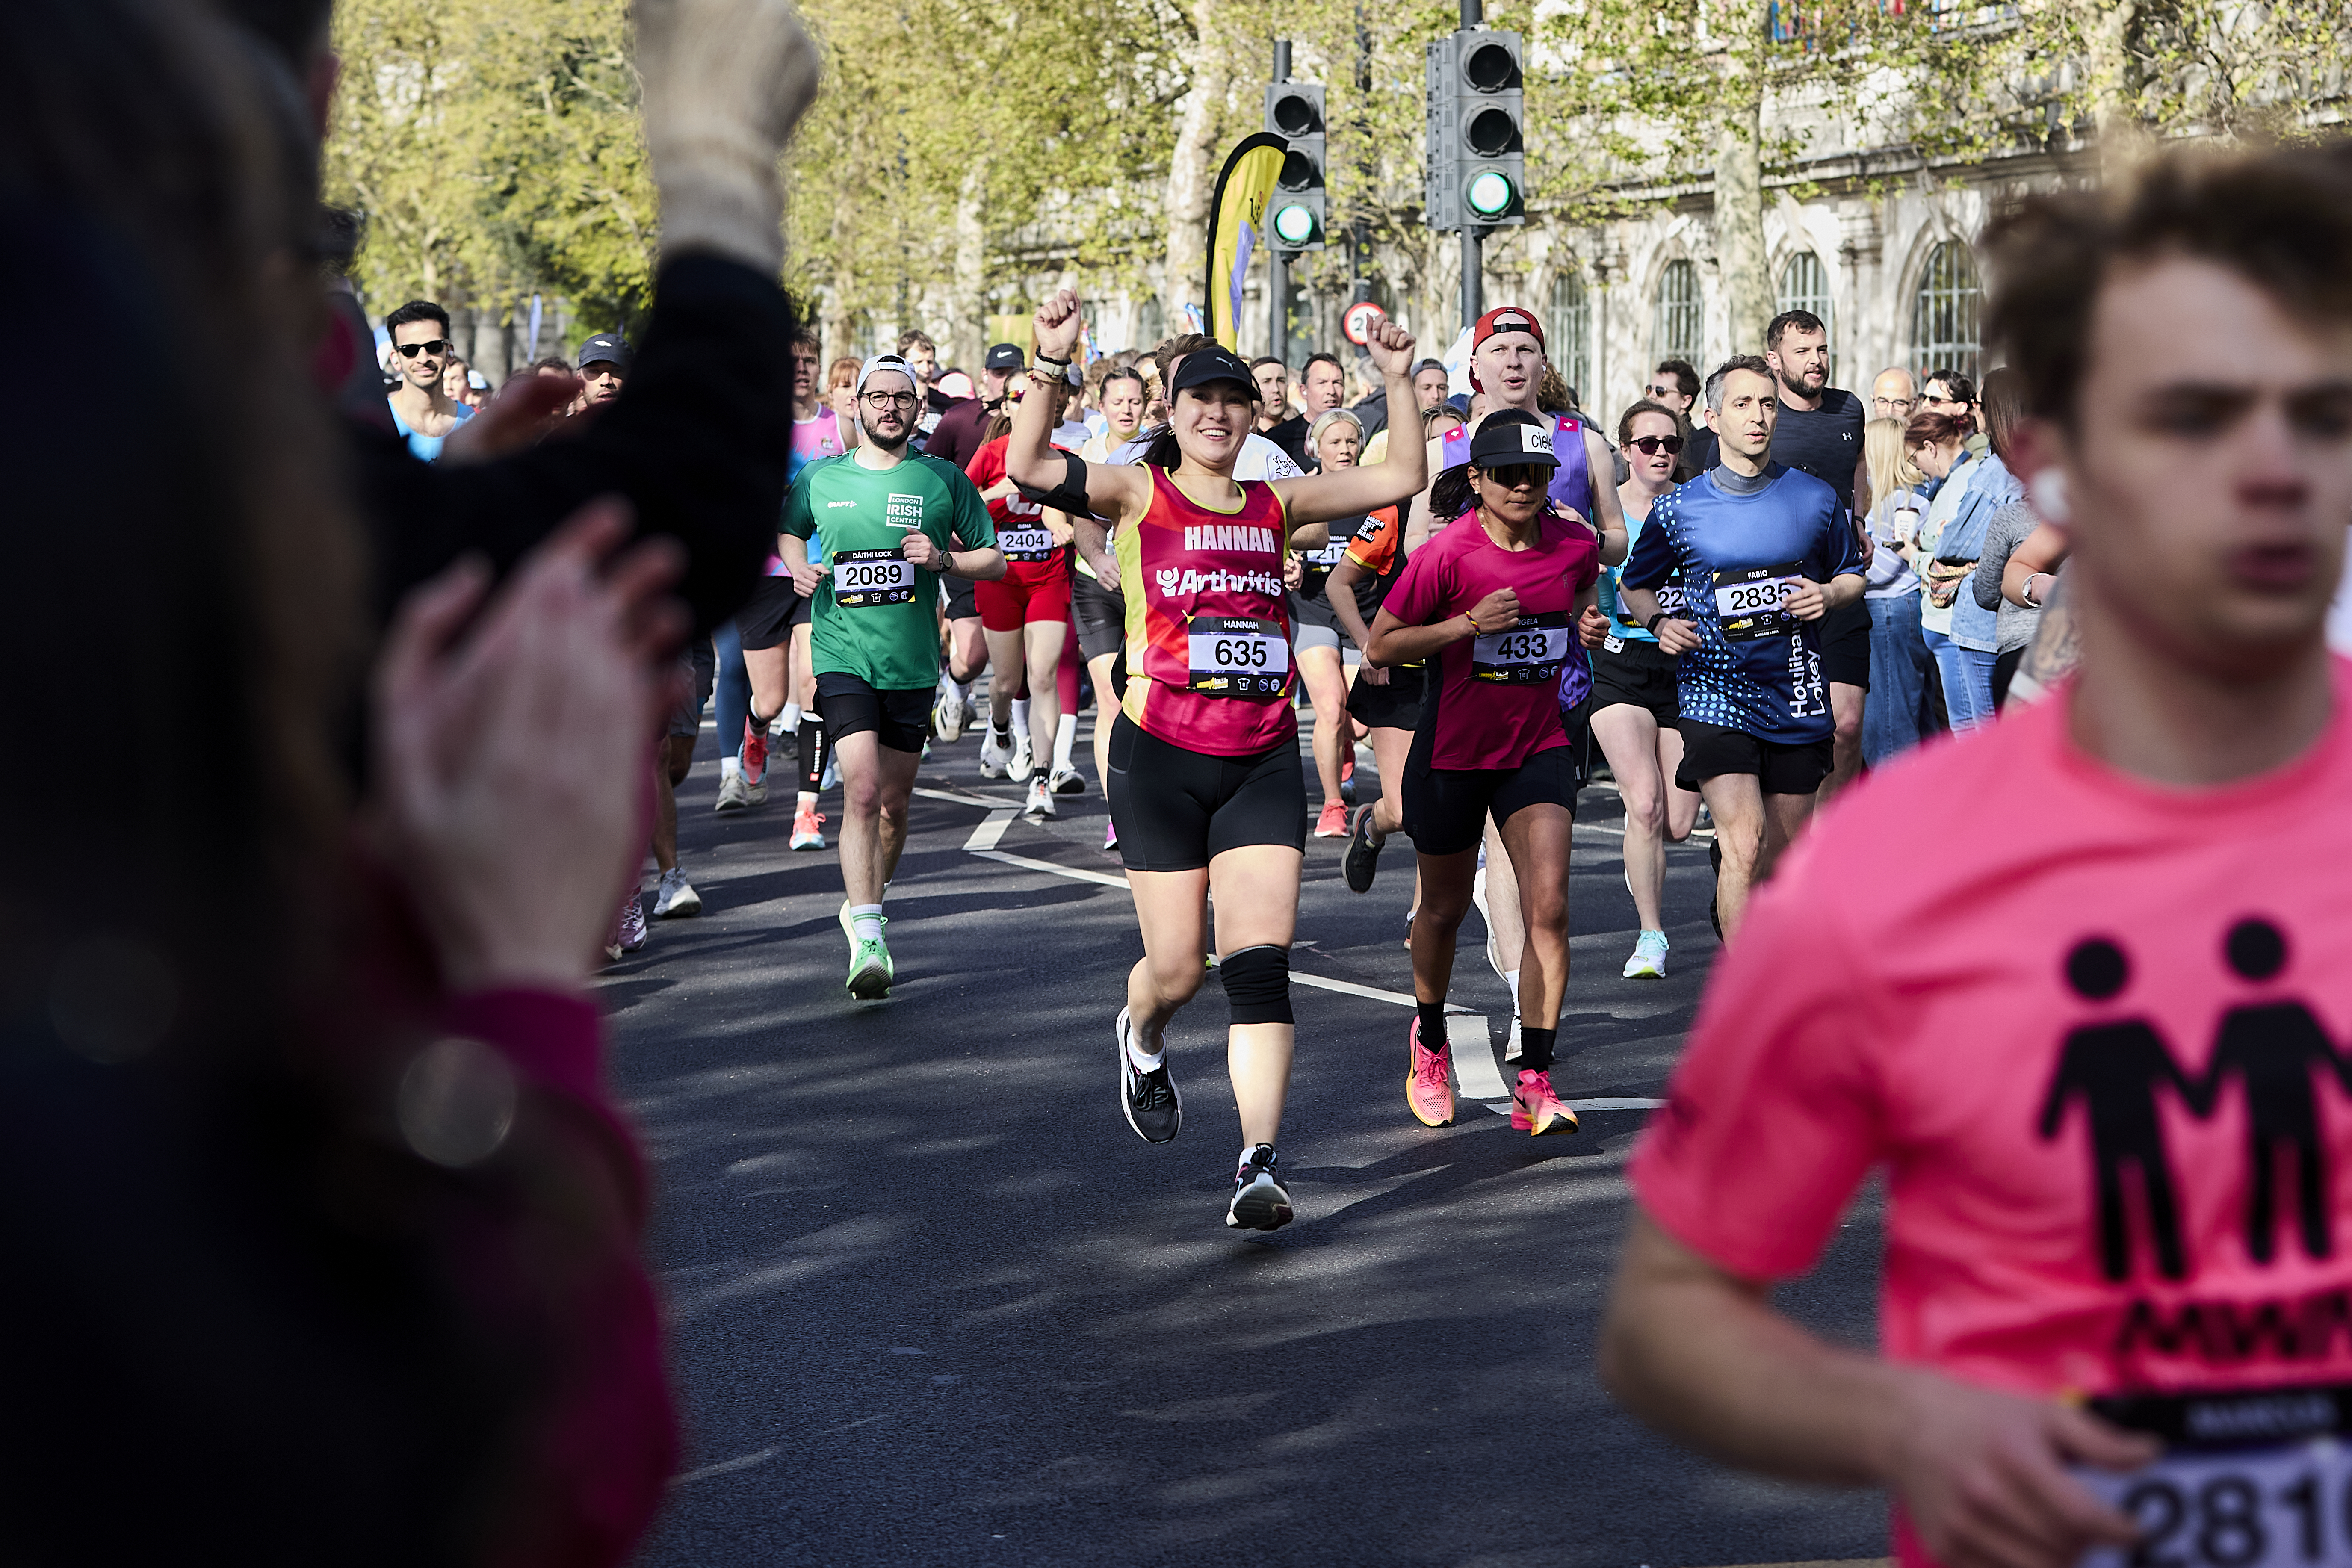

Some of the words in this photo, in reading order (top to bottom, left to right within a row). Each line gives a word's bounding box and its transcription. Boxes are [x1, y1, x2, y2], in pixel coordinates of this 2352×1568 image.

[1531, 431, 1553, 452] ciele
[886, 504, 922, 517] IRISH
[890, 516, 917, 524] CENTRE
[1005, 534, 1044, 547] 2404
[1185, 525, 1276, 554] HANNAH
[1317, 546, 1347, 559] 217
[846, 564, 902, 586] 2089
[1177, 569, 1282, 596] Arthritis
[1748, 570, 1768, 579] FABIO
[1657, 590, 1684, 608] 22
[1730, 582, 1791, 611] 2835
[1223, 620, 1259, 629] HANNAH
[1215, 639, 1267, 667] 635
[1498, 633, 1548, 659] 433
[1788, 629, 1808, 718] Houliha
[1807, 650, 1826, 716] Lokey
[2123, 1471, 2352, 1568] 281
